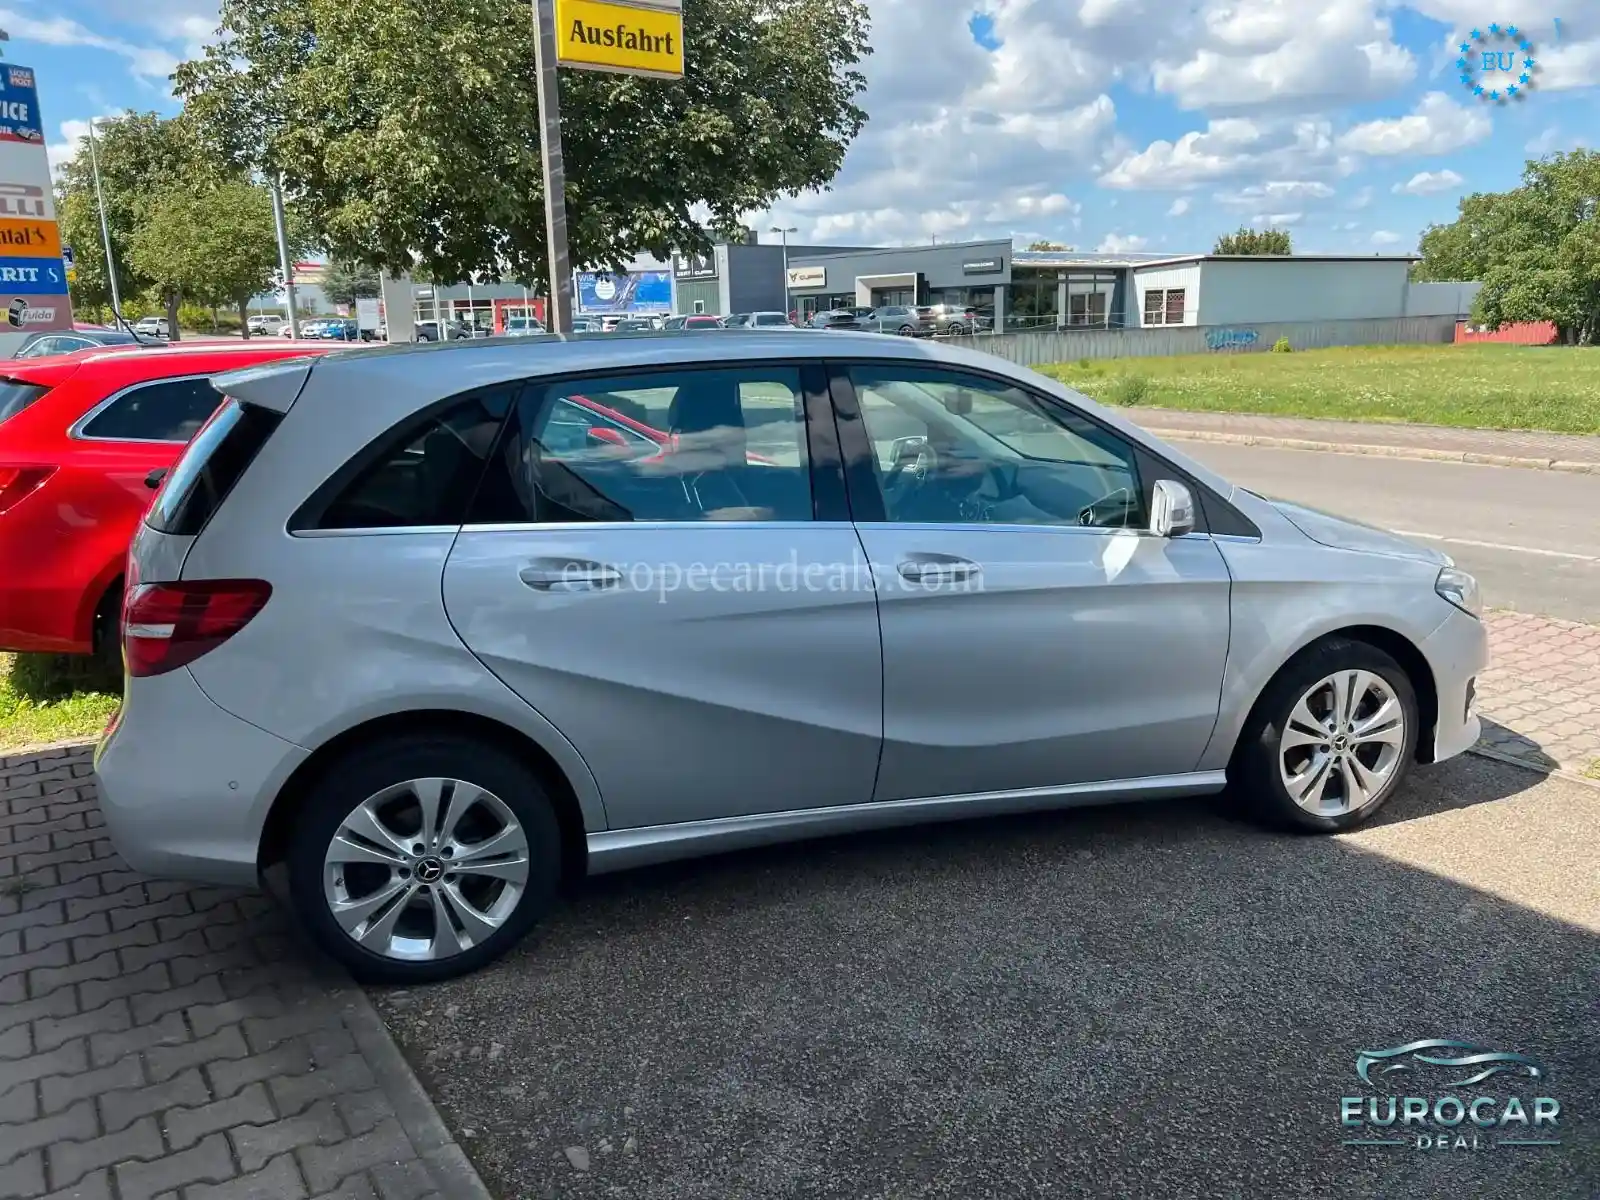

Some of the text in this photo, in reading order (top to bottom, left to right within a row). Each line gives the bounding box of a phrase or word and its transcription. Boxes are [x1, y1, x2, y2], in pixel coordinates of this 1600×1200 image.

[570, 20, 674, 55] Ausfahrt
[0, 101, 28, 121] ICE
[0, 267, 39, 282] RIT
[23, 311, 52, 320] Fulda
